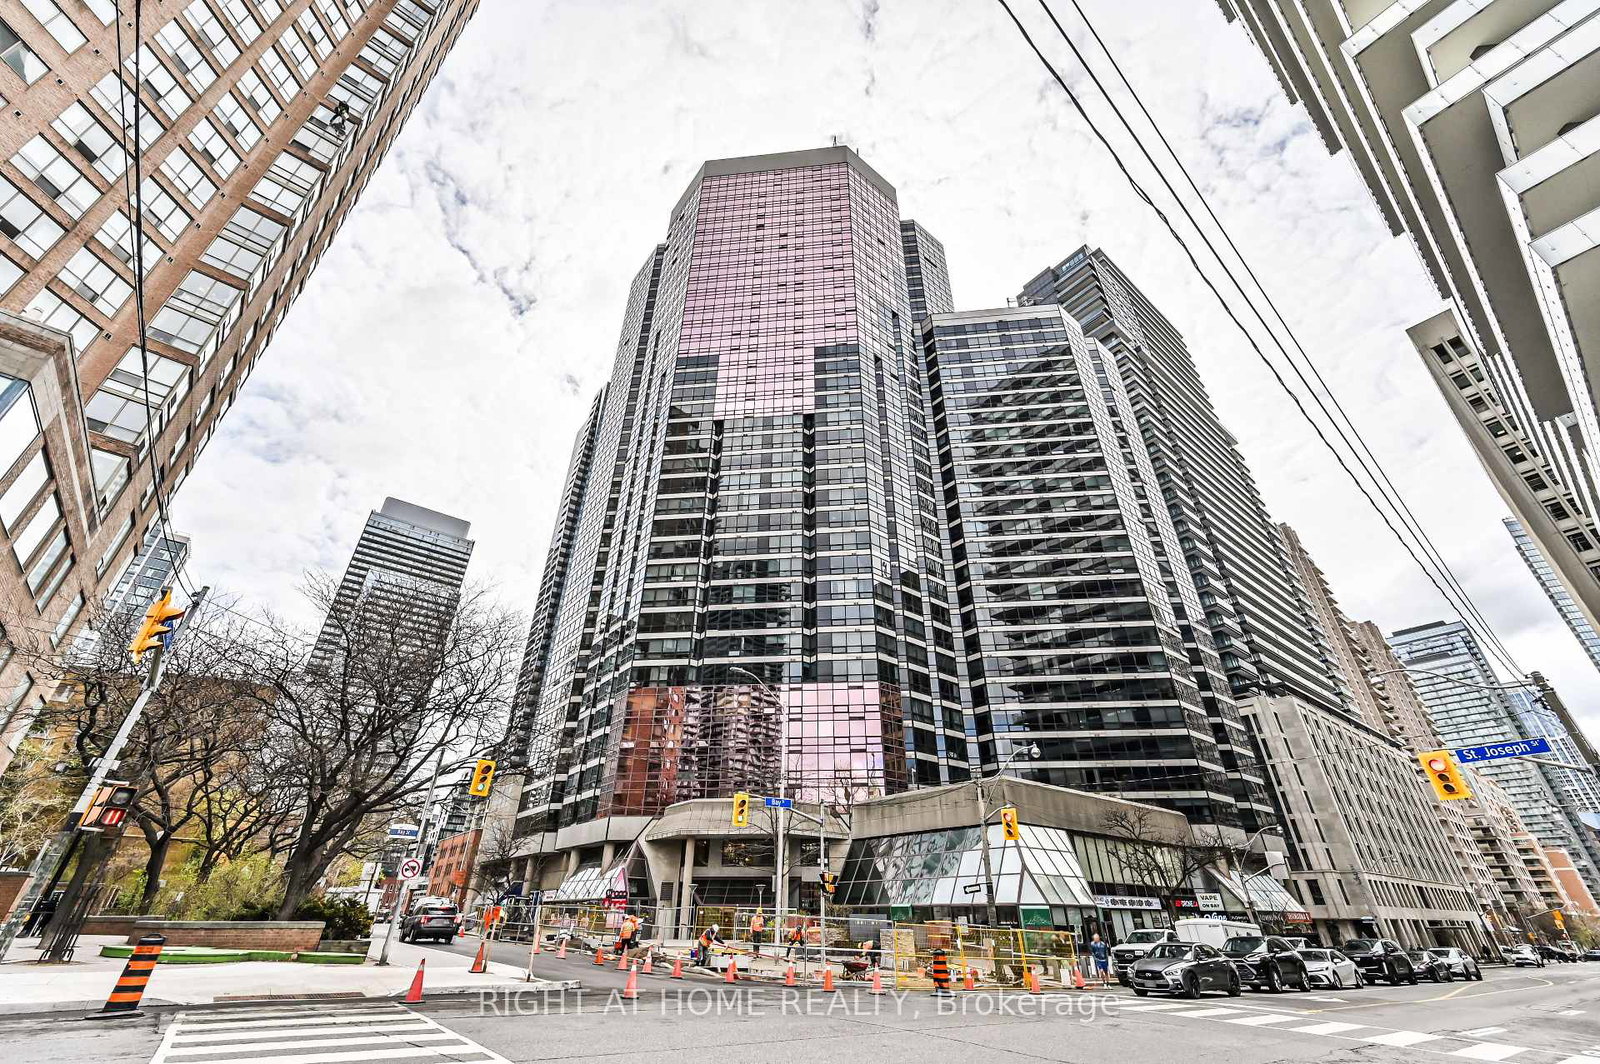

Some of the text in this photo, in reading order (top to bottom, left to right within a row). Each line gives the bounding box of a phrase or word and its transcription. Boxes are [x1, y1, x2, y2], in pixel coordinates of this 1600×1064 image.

[1463, 749, 1481, 760] St.
[1485, 743, 1530, 757] Joseph
[771, 798, 781, 807] Bay
